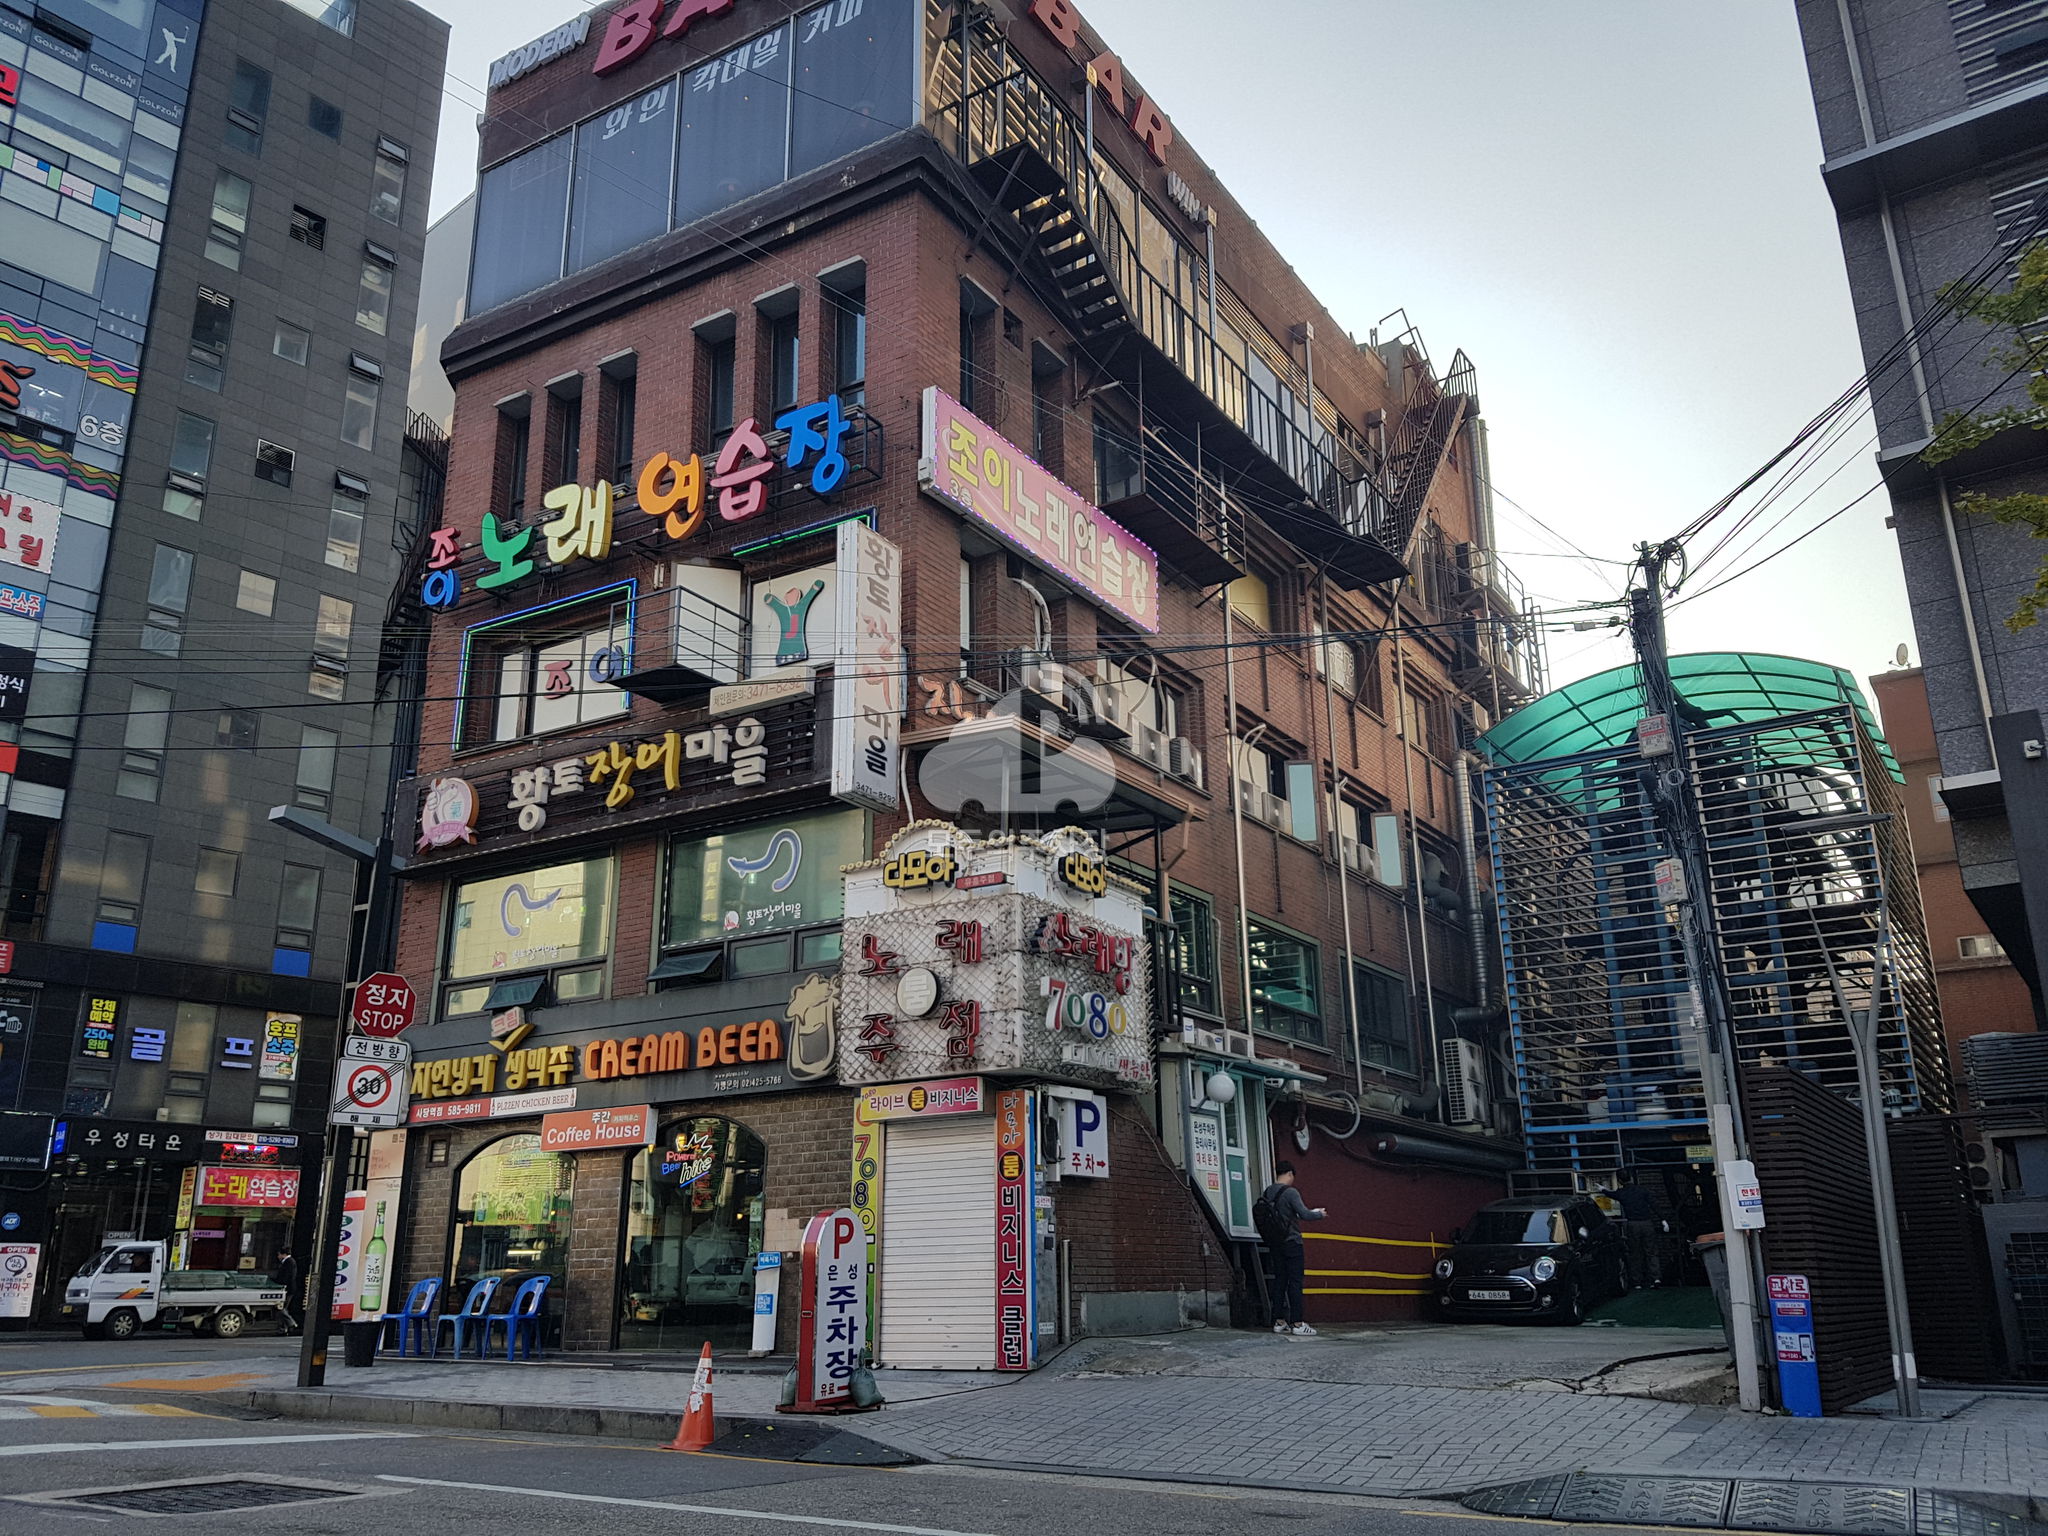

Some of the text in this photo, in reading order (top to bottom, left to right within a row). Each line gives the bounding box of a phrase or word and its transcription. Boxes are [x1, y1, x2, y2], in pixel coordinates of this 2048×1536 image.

[34, 35, 79, 62] GOLFZON
[489, 13, 591, 88] MODERN
[90, 63, 134, 89] GOLFZON
[602, 0, 863, 141] 와인 칵테일 커피
[138, 95, 178, 119] GOLFZON
[80, 414, 124, 445] 6층
[475, 394, 853, 594] 노래연습장
[421, 527, 462, 608] 조이
[507, 717, 769, 832] 황토장어마을
[855, 781, 896, 804] 3471-8292
[883, 848, 959, 889] 다모아
[1058, 852, 1107, 898] 다모아
[92, 999, 117, 1012] 단체
[366, 984, 409, 1010] 정지
[1040, 975, 1127, 1040] 7080
[90, 1010, 115, 1023] 예약
[360, 1010, 404, 1031] STOP
[269, 1020, 298, 1038] 호프
[266, 1037, 296, 1055] 소주
[356, 1041, 400, 1059] 전방향
[357, 1077, 381, 1095] 30
[448, 1103, 482, 1116] 585-9811
[522, 1097, 550, 1108] CHICKEN
[552, 1094, 569, 1105] BEER
[870, 1093, 905, 1112] 라이브
[930, 1088, 978, 1107] 비지니스
[592, 1111, 611, 1124] 주간
[1002, 1095, 1020, 1147] 다모아
[1075, 1100, 1101, 1148] P
[84, 1129, 182, 1151] 우성타운
[546, 1123, 641, 1144] Coffee House
[1071, 1153, 1095, 1173] 주차
[206, 1175, 298, 1199] 노래연습장
[108, 1231, 132, 1239] OPEN
[834, 1217, 855, 1259] P
[828, 1264, 858, 1280] 은성
[1001, 1185, 1023, 1366] 비지니스 클럽
[1771, 1277, 1807, 1292] 교차로
[825, 1286, 858, 1379] 주차장
[821, 1383, 835, 1396] 유료
